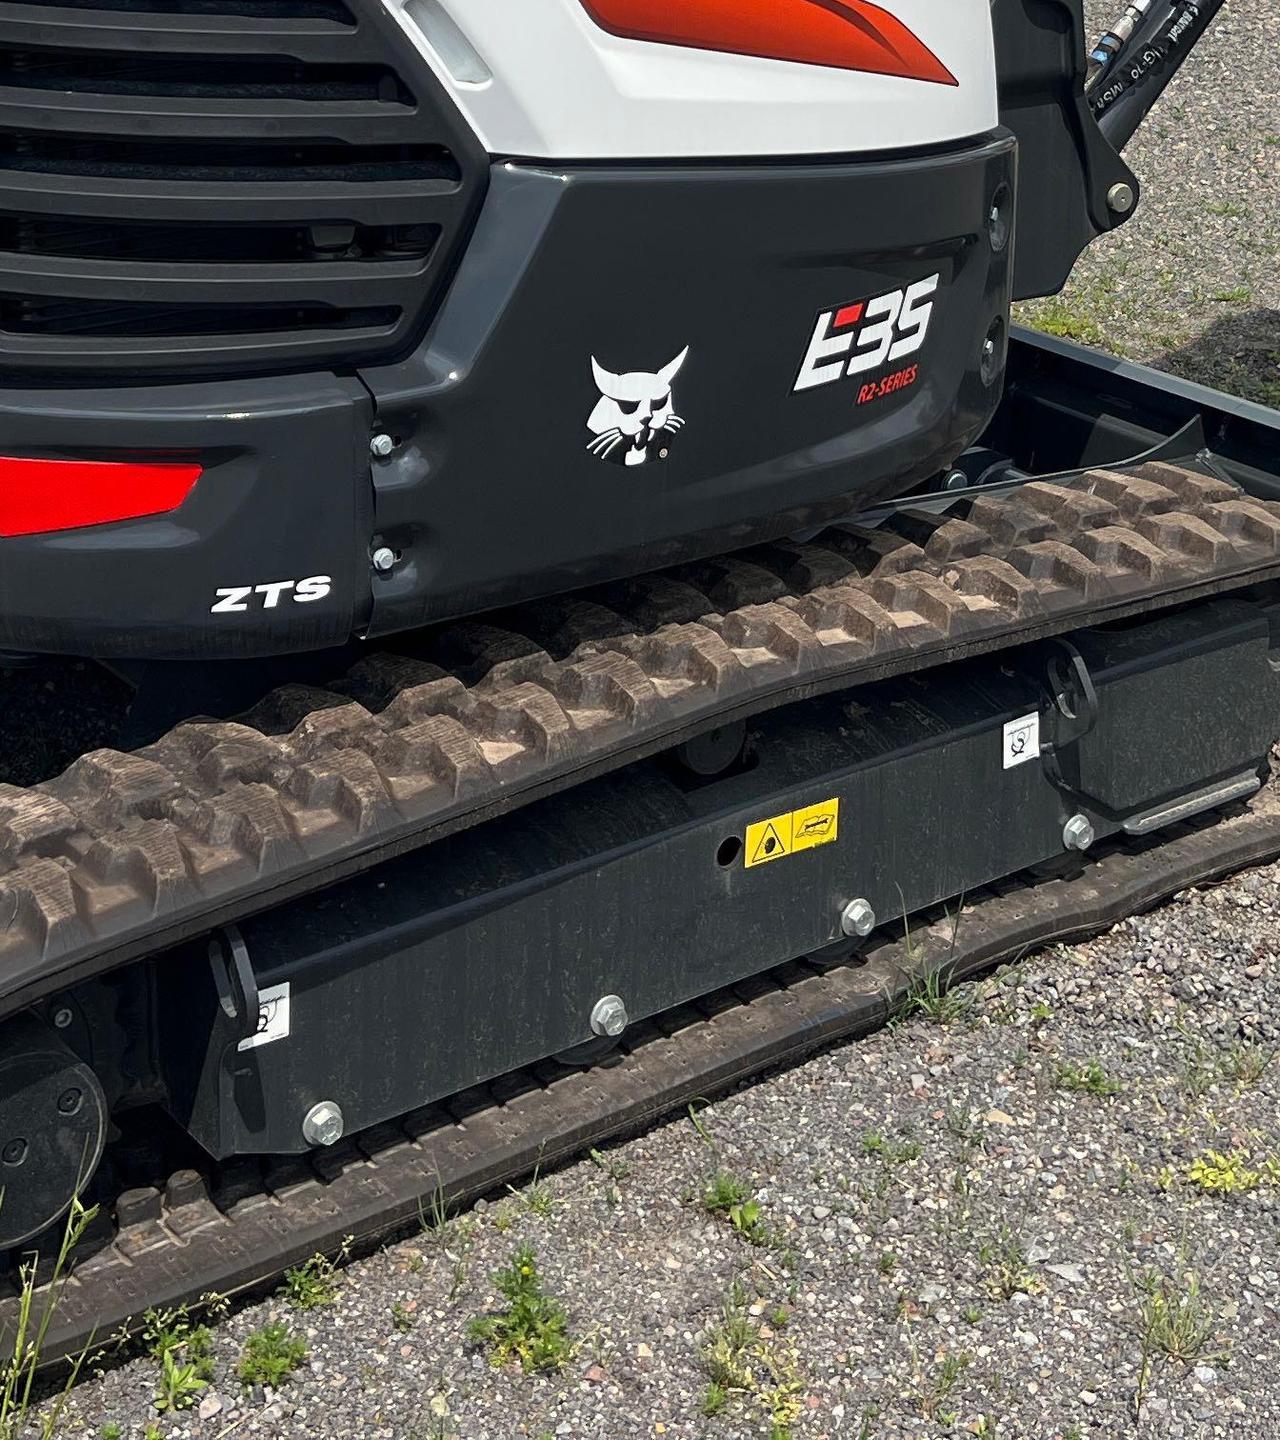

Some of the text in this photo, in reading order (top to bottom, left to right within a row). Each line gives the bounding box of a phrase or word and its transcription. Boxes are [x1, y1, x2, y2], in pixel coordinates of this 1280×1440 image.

[792, 272, 941, 392] E35
[856, 363, 920, 405] R2-SERIES
[210, 575, 332, 613] ZTS
